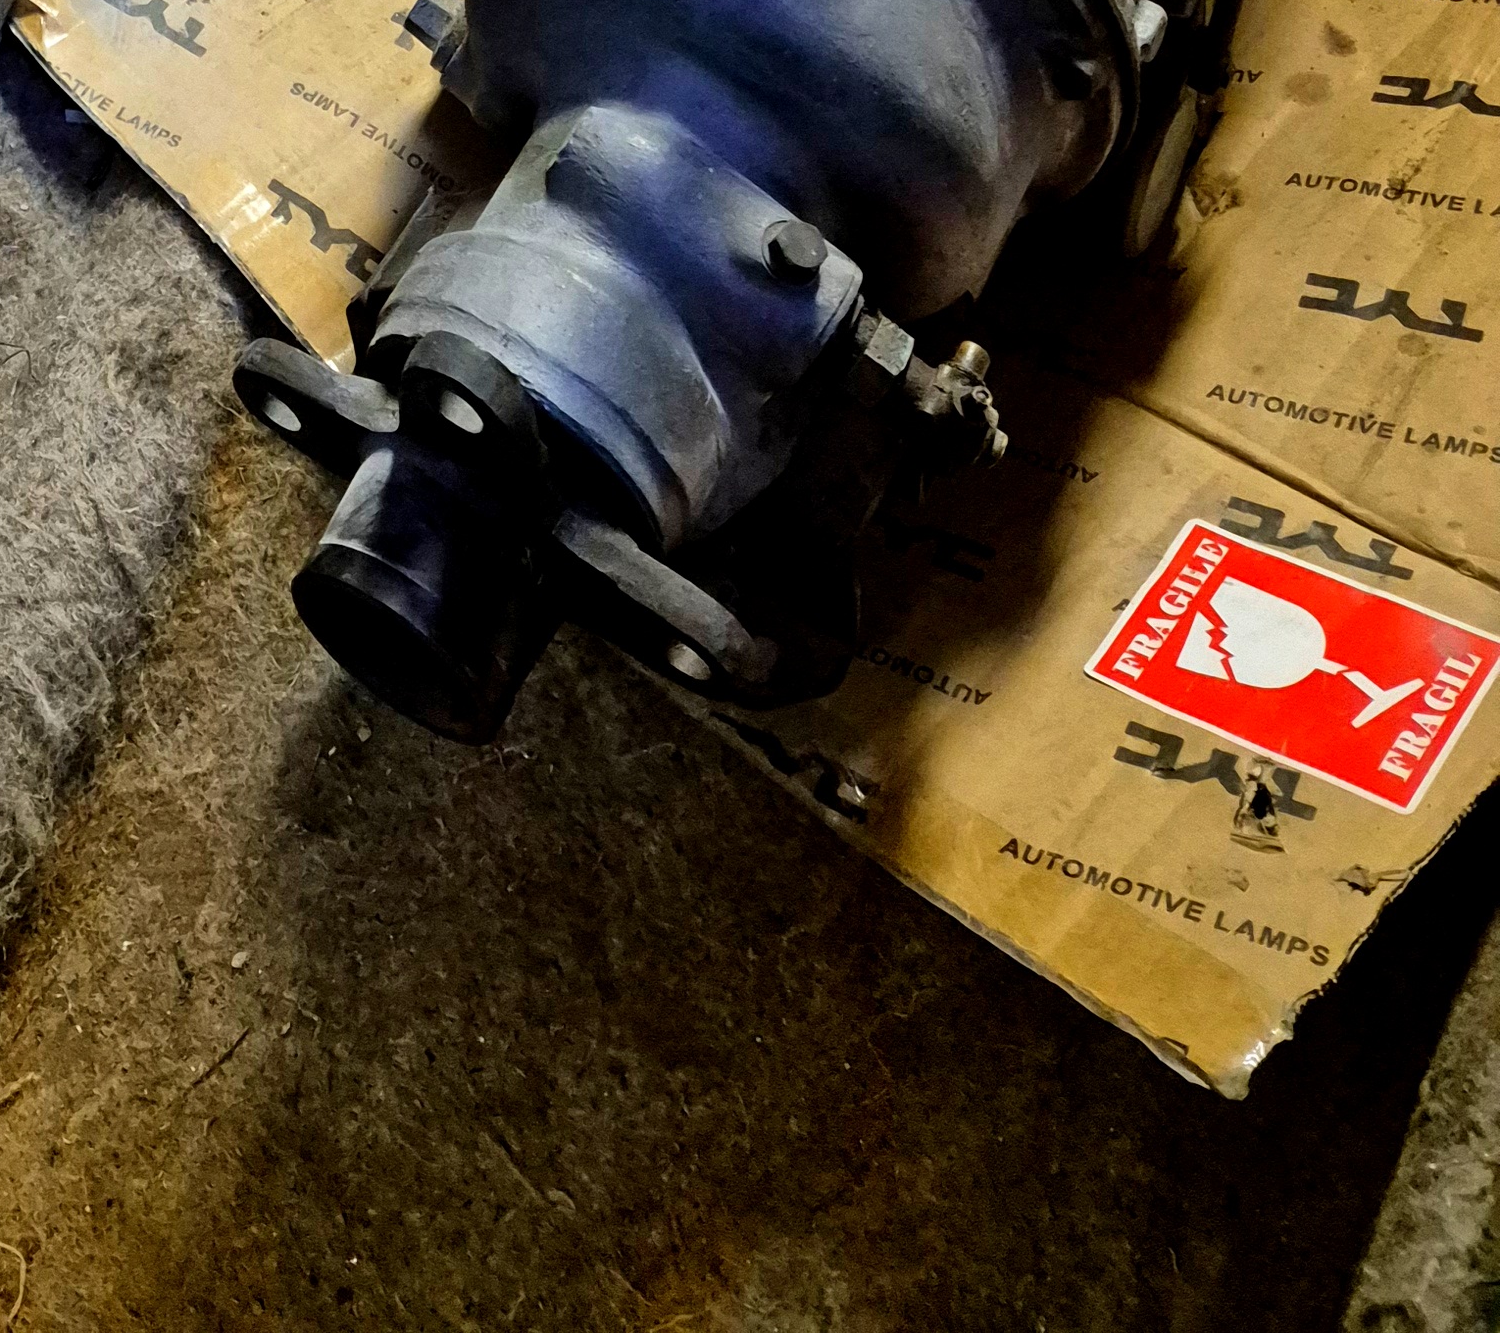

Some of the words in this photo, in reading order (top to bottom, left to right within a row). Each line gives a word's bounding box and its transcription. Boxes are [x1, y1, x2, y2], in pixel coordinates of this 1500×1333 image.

[115, 106, 183, 148] LAMPS
[289, 81, 360, 127] LAMPS
[1285, 172, 1465, 212] AUTOMOTIVE
[1206, 384, 1396, 439] AUTOMOTIVE
[1403, 426, 1500, 464] LAMPS
[1111, 536, 1230, 682] FRAGILE
[1377, 651, 1483, 783] FRAGIL
[999, 838, 1208, 924] AUTOMOTIVE
[1214, 908, 1332, 969] LAMPS
